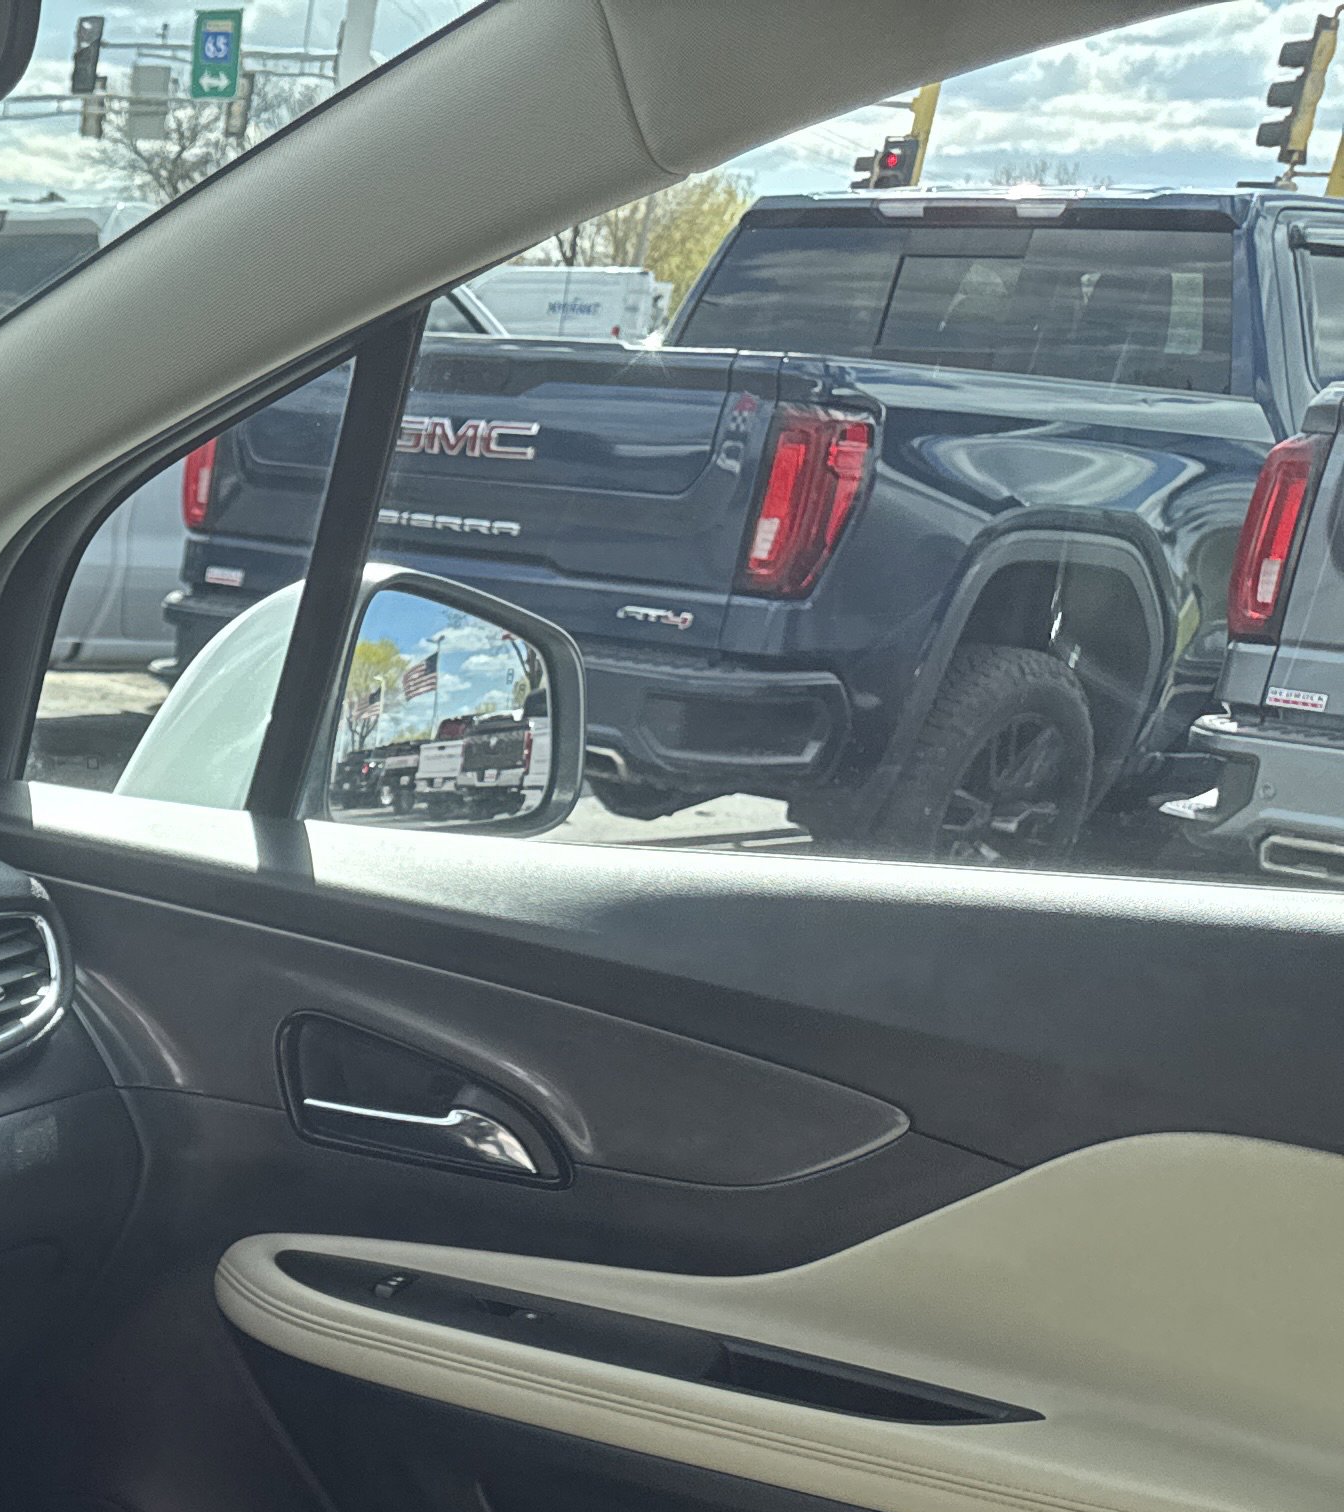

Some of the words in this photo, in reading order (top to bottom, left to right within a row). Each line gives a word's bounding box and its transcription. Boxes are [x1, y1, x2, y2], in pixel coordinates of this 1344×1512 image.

[204, 34, 229, 58] 65
[395, 415, 540, 460] GMC
[377, 508, 521, 537] SIERRA
[616, 605, 694, 630] AT4
